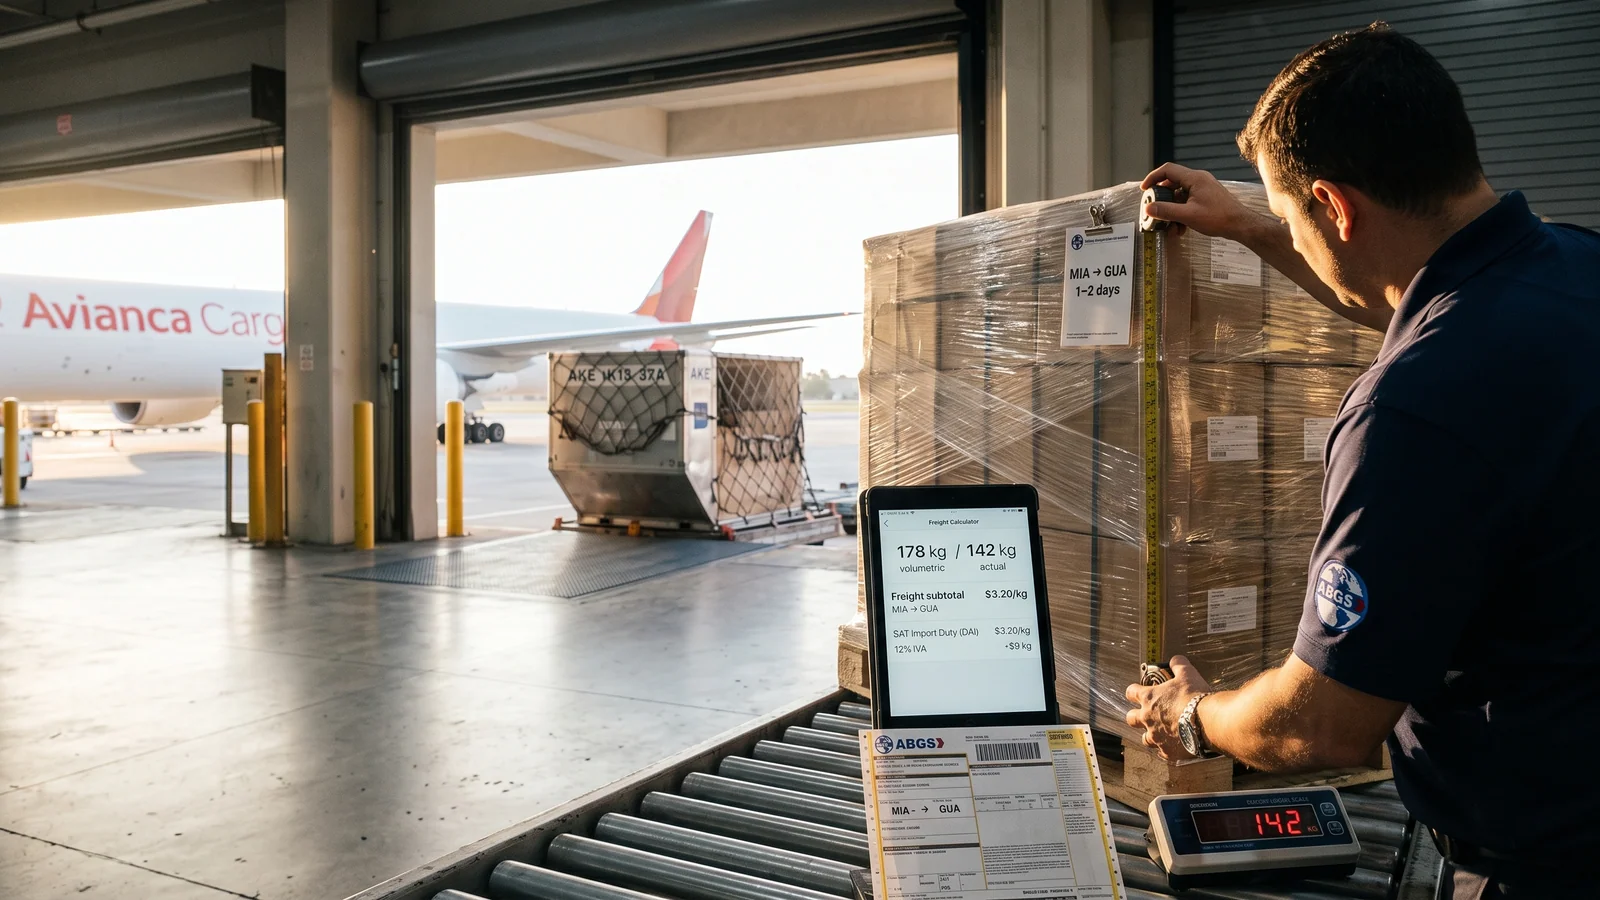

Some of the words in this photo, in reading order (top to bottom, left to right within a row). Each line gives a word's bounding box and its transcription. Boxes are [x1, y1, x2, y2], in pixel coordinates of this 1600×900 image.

[1069, 268, 1090, 279] MIA
[1104, 264, 1127, 278] GUA
[1096, 284, 1120, 298] days
[23, 292, 192, 334] Avianca
[568, 368, 596, 381] AKE
[690, 367, 711, 380] AKE
[928, 519, 949, 527] Freight
[949, 518, 980, 526] Calculator
[897, 544, 926, 559] 178
[929, 544, 947, 561] kg
[966, 543, 996, 557] 142
[999, 543, 1017, 560] kg
[899, 563, 946, 573] volumetric
[980, 561, 1007, 571] actual
[891, 592, 925, 603] Freight
[926, 590, 965, 601] subtotal
[985, 589, 1028, 601] $3.20/kg
[1317, 580, 1354, 608] ABGS
[892, 605, 909, 614] MIA
[919, 604, 939, 613] GUA
[893, 630, 910, 639] SAT
[911, 629, 937, 640] Import
[938, 628, 958, 639] Duty
[959, 628, 980, 638] (DAI)
[994, 626, 1031, 637] $3.20/kg
[894, 644, 912, 653] 12%
[913, 644, 928, 653] IVA
[1022, 641, 1032, 652] kg
[895, 737, 937, 750] ABGS
[939, 804, 961, 814] GUA
[1255, 809, 1302, 836] 142
[1306, 825, 1319, 833] KG
